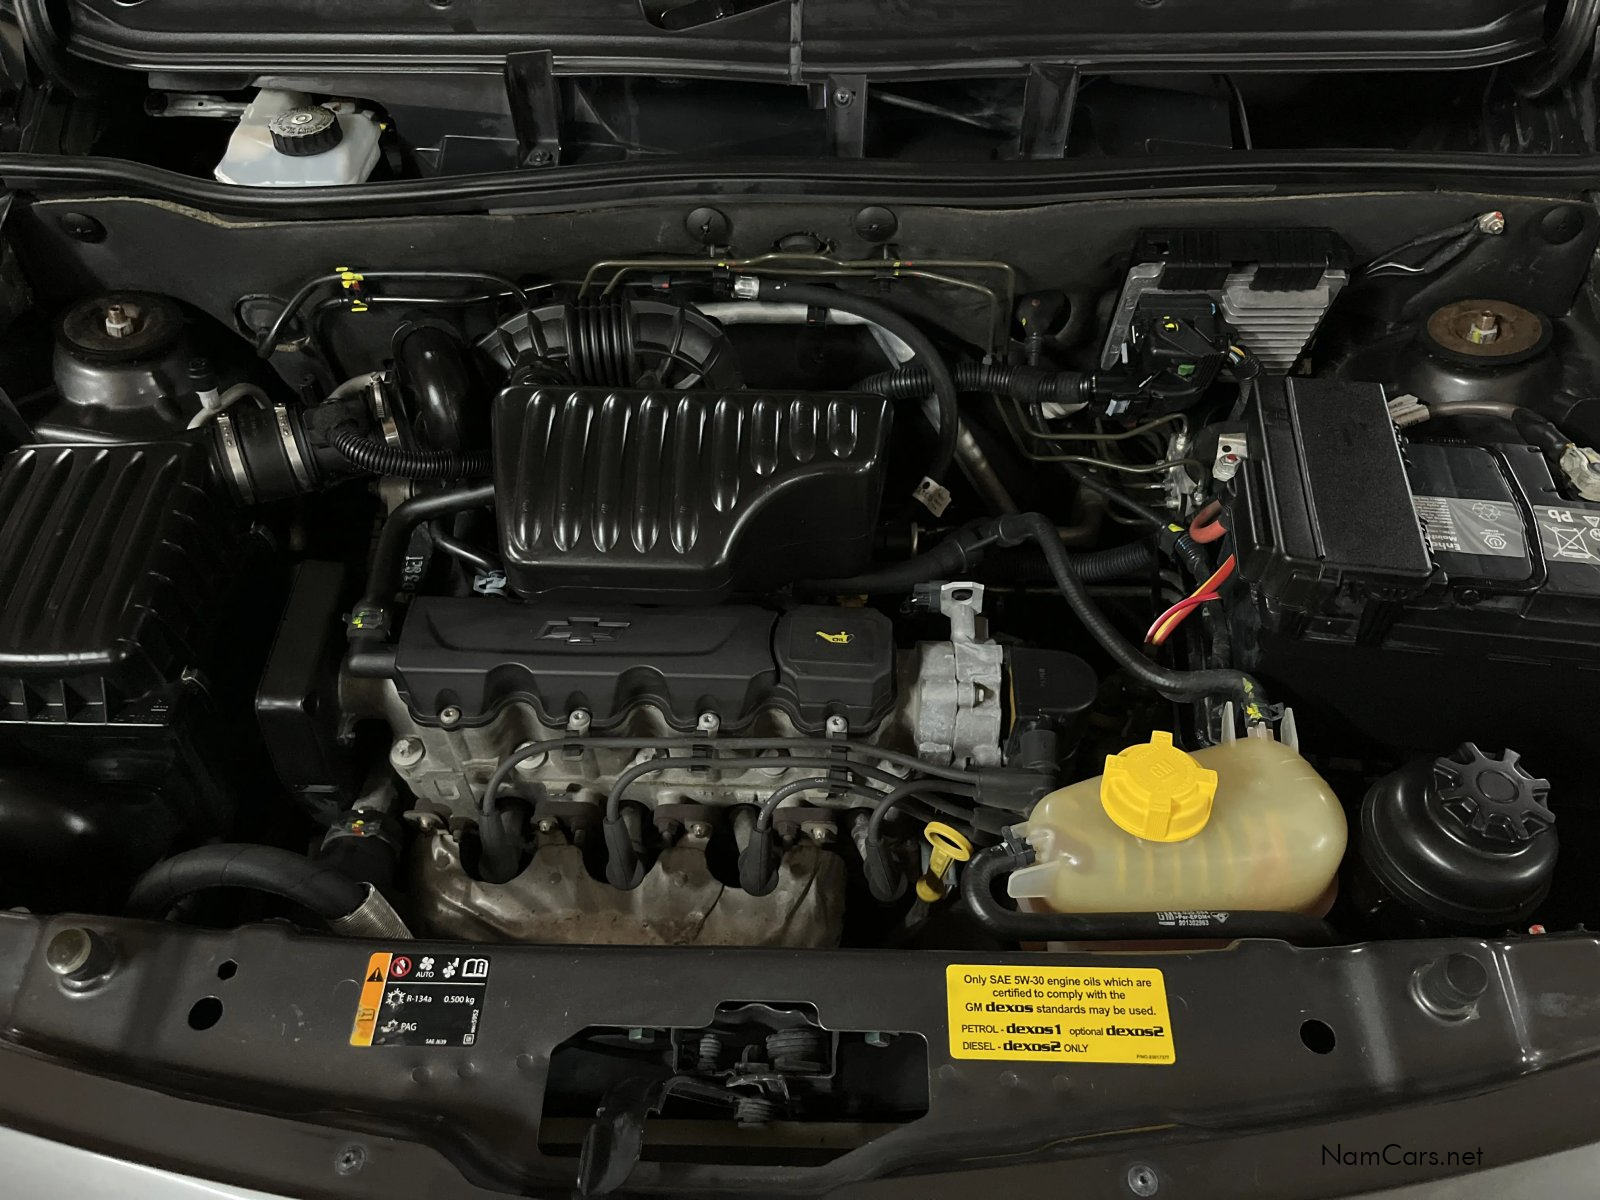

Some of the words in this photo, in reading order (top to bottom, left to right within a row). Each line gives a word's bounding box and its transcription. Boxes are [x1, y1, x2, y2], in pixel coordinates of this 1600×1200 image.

[1548, 509, 1574, 523] Pb
[964, 974, 987, 986] Only
[989, 974, 1012, 984] SAE
[1014, 975, 1044, 985] 5W-30
[1047, 976, 1081, 988] engine
[1083, 977, 1101, 986] oils
[1103, 977, 1133, 987] which
[1136, 979, 1152, 987] are
[406, 995, 433, 1003] R-134a
[443, 996, 464, 1004] 0.500
[465, 996, 475, 1006] kg
[992, 988, 1032, 998] certified
[1034, 989, 1044, 998] to
[1046, 989, 1083, 1001] comply
[1086, 989, 1107, 999] with
[1109, 990, 1126, 1000] the
[965, 1002, 982, 1012] GM
[985, 1001, 1034, 1013] dexos
[1036, 1004, 1086, 1014] standards
[1089, 1006, 1110, 1017] may
[1113, 1005, 1126, 1015] be
[1129, 1006, 1156, 1016] used.
[400, 1022, 417, 1031] PAG
[961, 1024, 999, 1033] PETROL
[1006, 1023, 1062, 1035] dexos1
[1069, 1026, 1104, 1037] optional
[1106, 1025, 1165, 1037] dexos2
[962, 1041, 995, 1051] DIESEL
[1003, 1040, 1062, 1052] dexos2
[1064, 1043, 1089, 1053] ONLY
